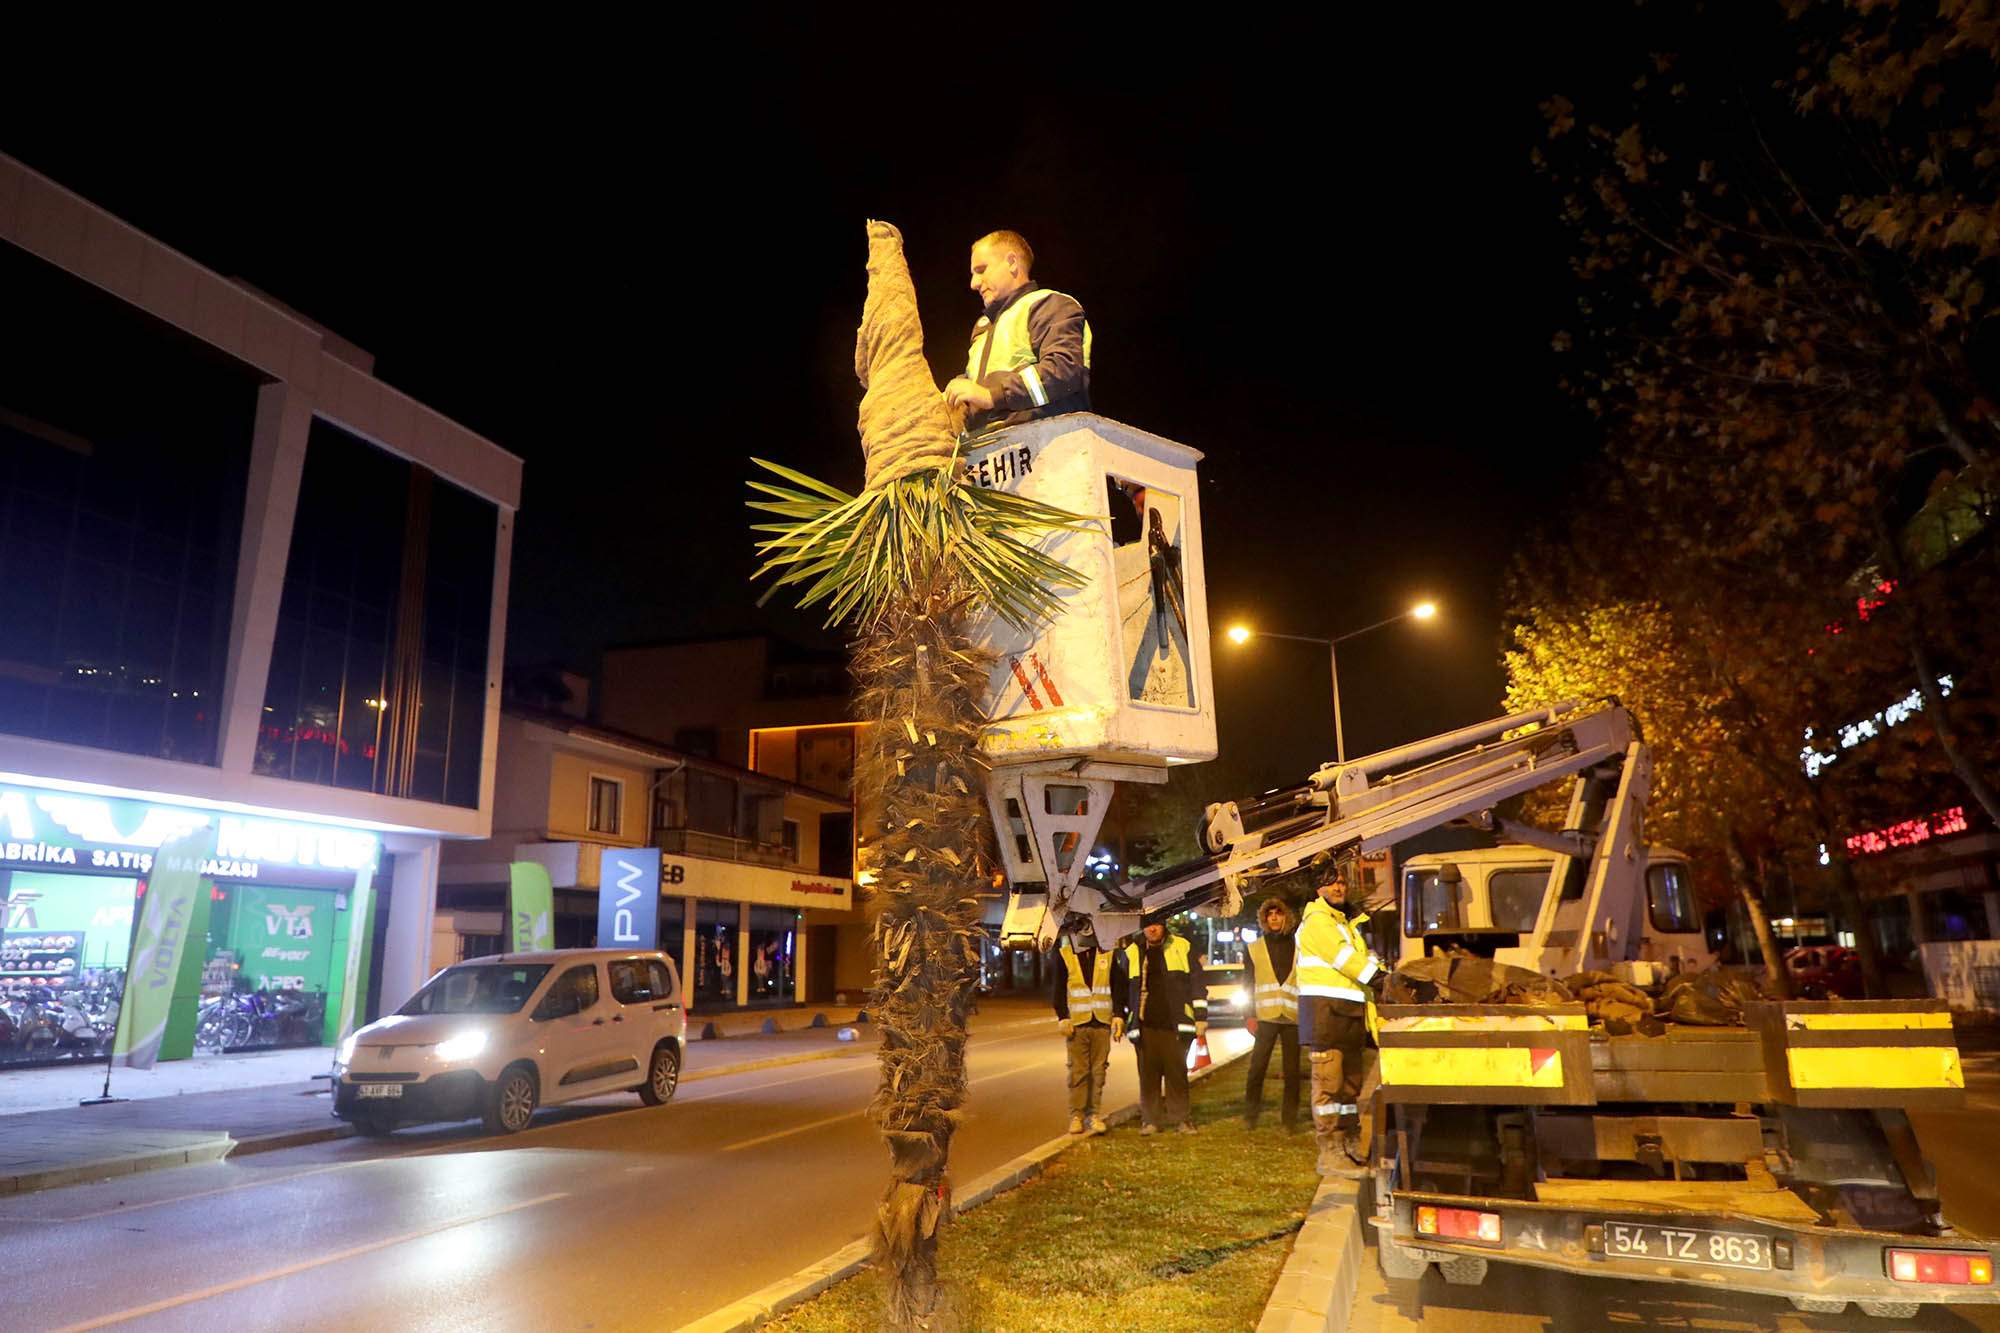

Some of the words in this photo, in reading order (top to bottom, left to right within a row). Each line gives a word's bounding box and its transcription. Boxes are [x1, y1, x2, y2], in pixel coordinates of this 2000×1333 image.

[92, 850, 153, 873] SATIŞ
[614, 860, 643, 942] PW
[151, 896, 188, 988] VOLTA
[1615, 1226, 1648, 1254] 54
[1661, 1230, 1699, 1259] TZ
[1709, 1235, 1761, 1264] 863
